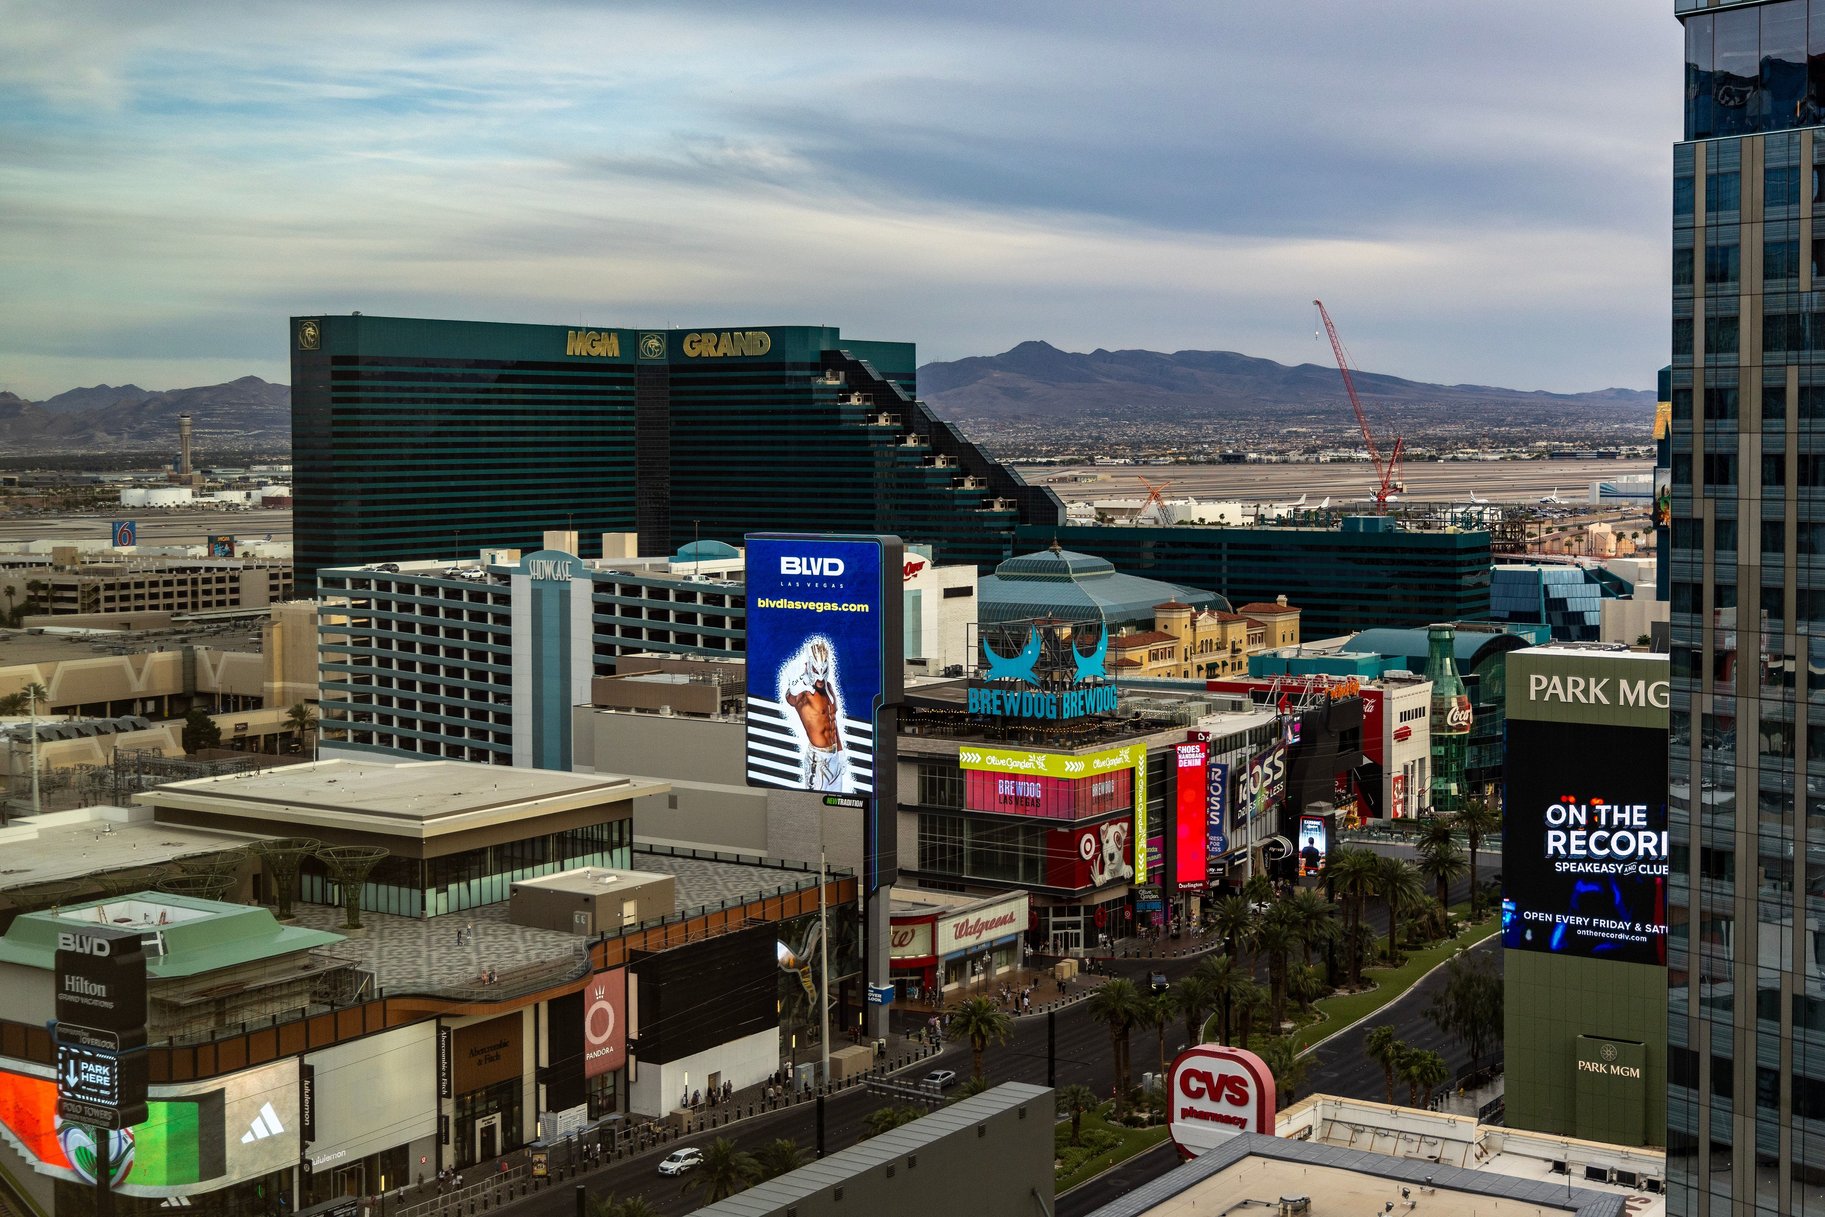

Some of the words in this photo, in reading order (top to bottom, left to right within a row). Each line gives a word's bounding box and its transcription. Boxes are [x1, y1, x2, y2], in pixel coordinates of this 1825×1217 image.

[566, 331, 620, 357] MGM
[683, 331, 771, 358] GRAND
[117, 522, 132, 546] 6
[529, 559, 572, 581] SHOWCASE
[780, 556, 845, 577] BLVD
[757, 598, 869, 613] blvdlasvegas.com
[1529, 674, 1610, 705] PARK
[968, 688, 1057, 720] BREWDOG
[1063, 684, 1117, 720] BREWDOG
[1177, 745, 1200, 754] SHOES
[1178, 759, 1201, 767] DENIM
[1239, 748, 1284, 804] ROSS
[998, 779, 1041, 798] BREWDOG
[1210, 768, 1222, 825] ROSS
[1270, 781, 1284, 798] LESS
[999, 795, 1013, 804] LAS
[1014, 797, 1041, 808] VEGAS
[1546, 804, 1586, 825] ON
[1595, 805, 1647, 826] THE
[1555, 862, 1624, 874] SPEAKEASY
[953, 911, 1016, 940] Walgreens
[1523, 911, 1553, 922] OPEN
[1555, 914, 1590, 926] EVERY
[1592, 918, 1632, 931] FRIDAY
[1634, 922, 1642, 932] &
[58, 932, 110, 957] BLVD
[1576, 929, 1647, 942] ontherecordlv.com
[64, 974, 107, 998] Hilton
[58, 993, 80, 1003] GRAND
[81, 996, 114, 1010] VACATIONS
[81, 1036, 116, 1050] OVERLOOK
[586, 1046, 614, 1061] PANDORA
[81, 1061, 110, 1076] PARK
[1578, 1060, 1608, 1074] PARK
[1610, 1065, 1640, 1079] MGM
[81, 1072, 110, 1086] HERE
[1179, 1068, 1250, 1107] CVS
[63, 1102, 83, 1114] POLO
[83, 1106, 113, 1121] TOWERS
[1181, 1106, 1248, 1130] pharmacy
